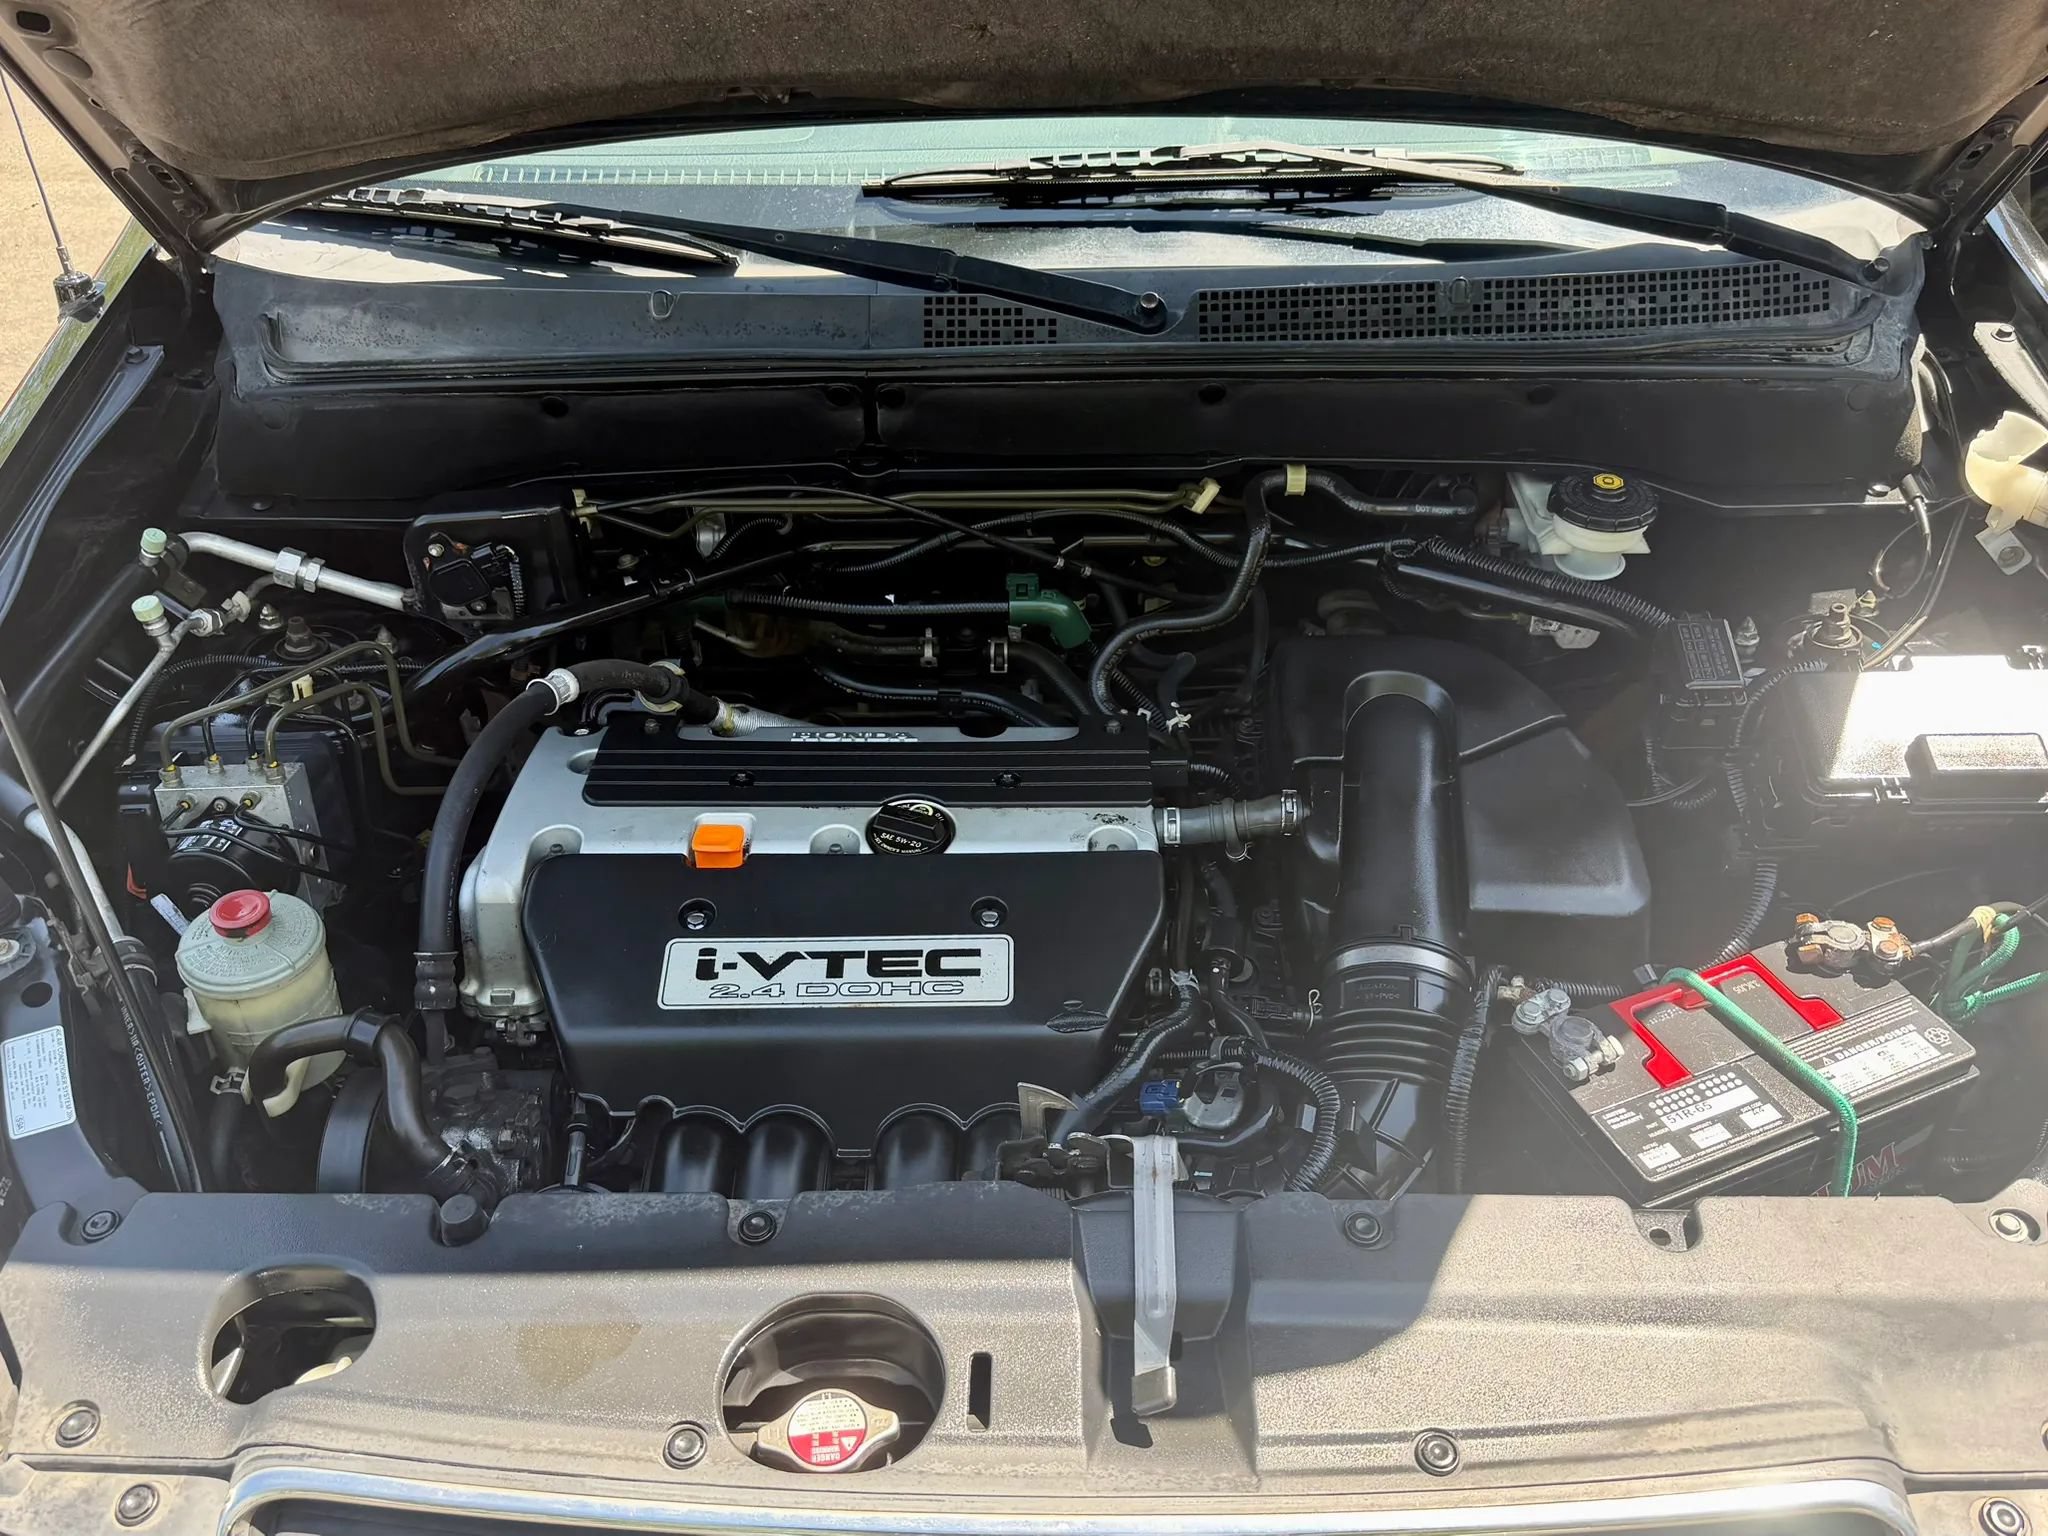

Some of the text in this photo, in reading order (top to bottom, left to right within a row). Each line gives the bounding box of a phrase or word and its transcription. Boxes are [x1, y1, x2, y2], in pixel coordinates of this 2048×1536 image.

[790, 731, 918, 743] HONDA
[880, 832, 922, 848] SAE 5W-20
[695, 947, 982, 981] i-VTEC
[708, 980, 964, 999] 2.4 DOHC
[1835, 1023, 1917, 1060] DANGER/POISON
[57, 1047, 68, 1084] CONDITIONER
[63, 1085, 72, 1110] SYSTEM
[1666, 1102, 1713, 1124] 51R-65
